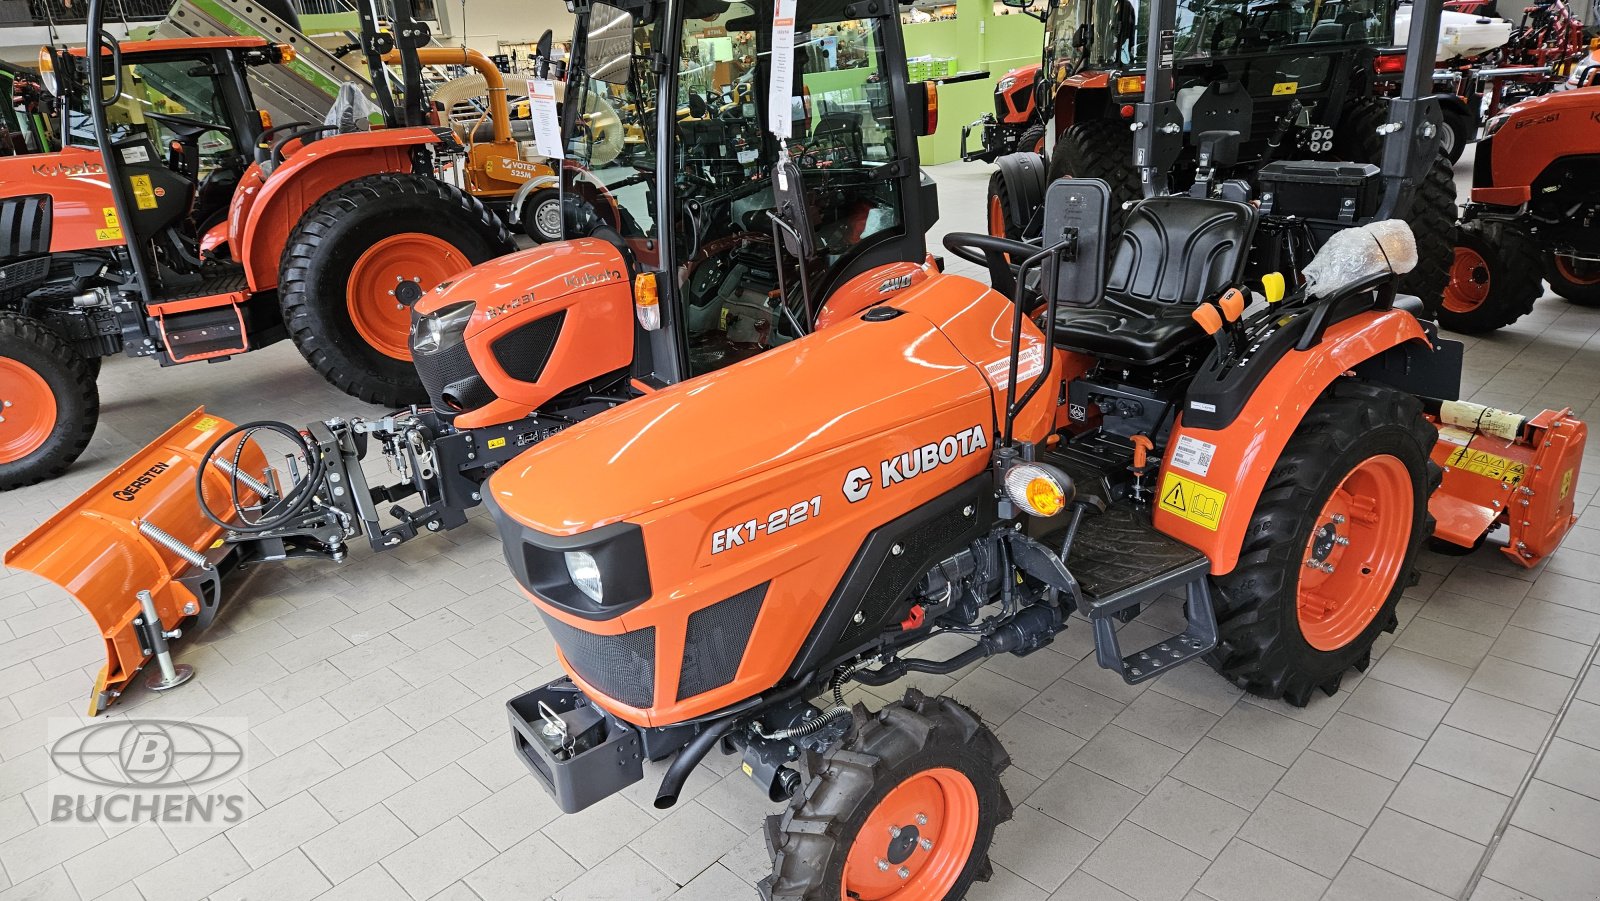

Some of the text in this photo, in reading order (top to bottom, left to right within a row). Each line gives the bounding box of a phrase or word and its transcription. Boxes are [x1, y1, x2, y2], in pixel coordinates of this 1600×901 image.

[32, 161, 105, 177] Kubota
[510, 170, 531, 179] 525M
[512, 161, 536, 171] VOTEX
[564, 269, 622, 288] Kubota
[879, 273, 913, 293] 4WD
[485, 292, 535, 321] BX-231
[880, 423, 988, 490] KUBOTA
[710, 495, 822, 556] EK1-221
